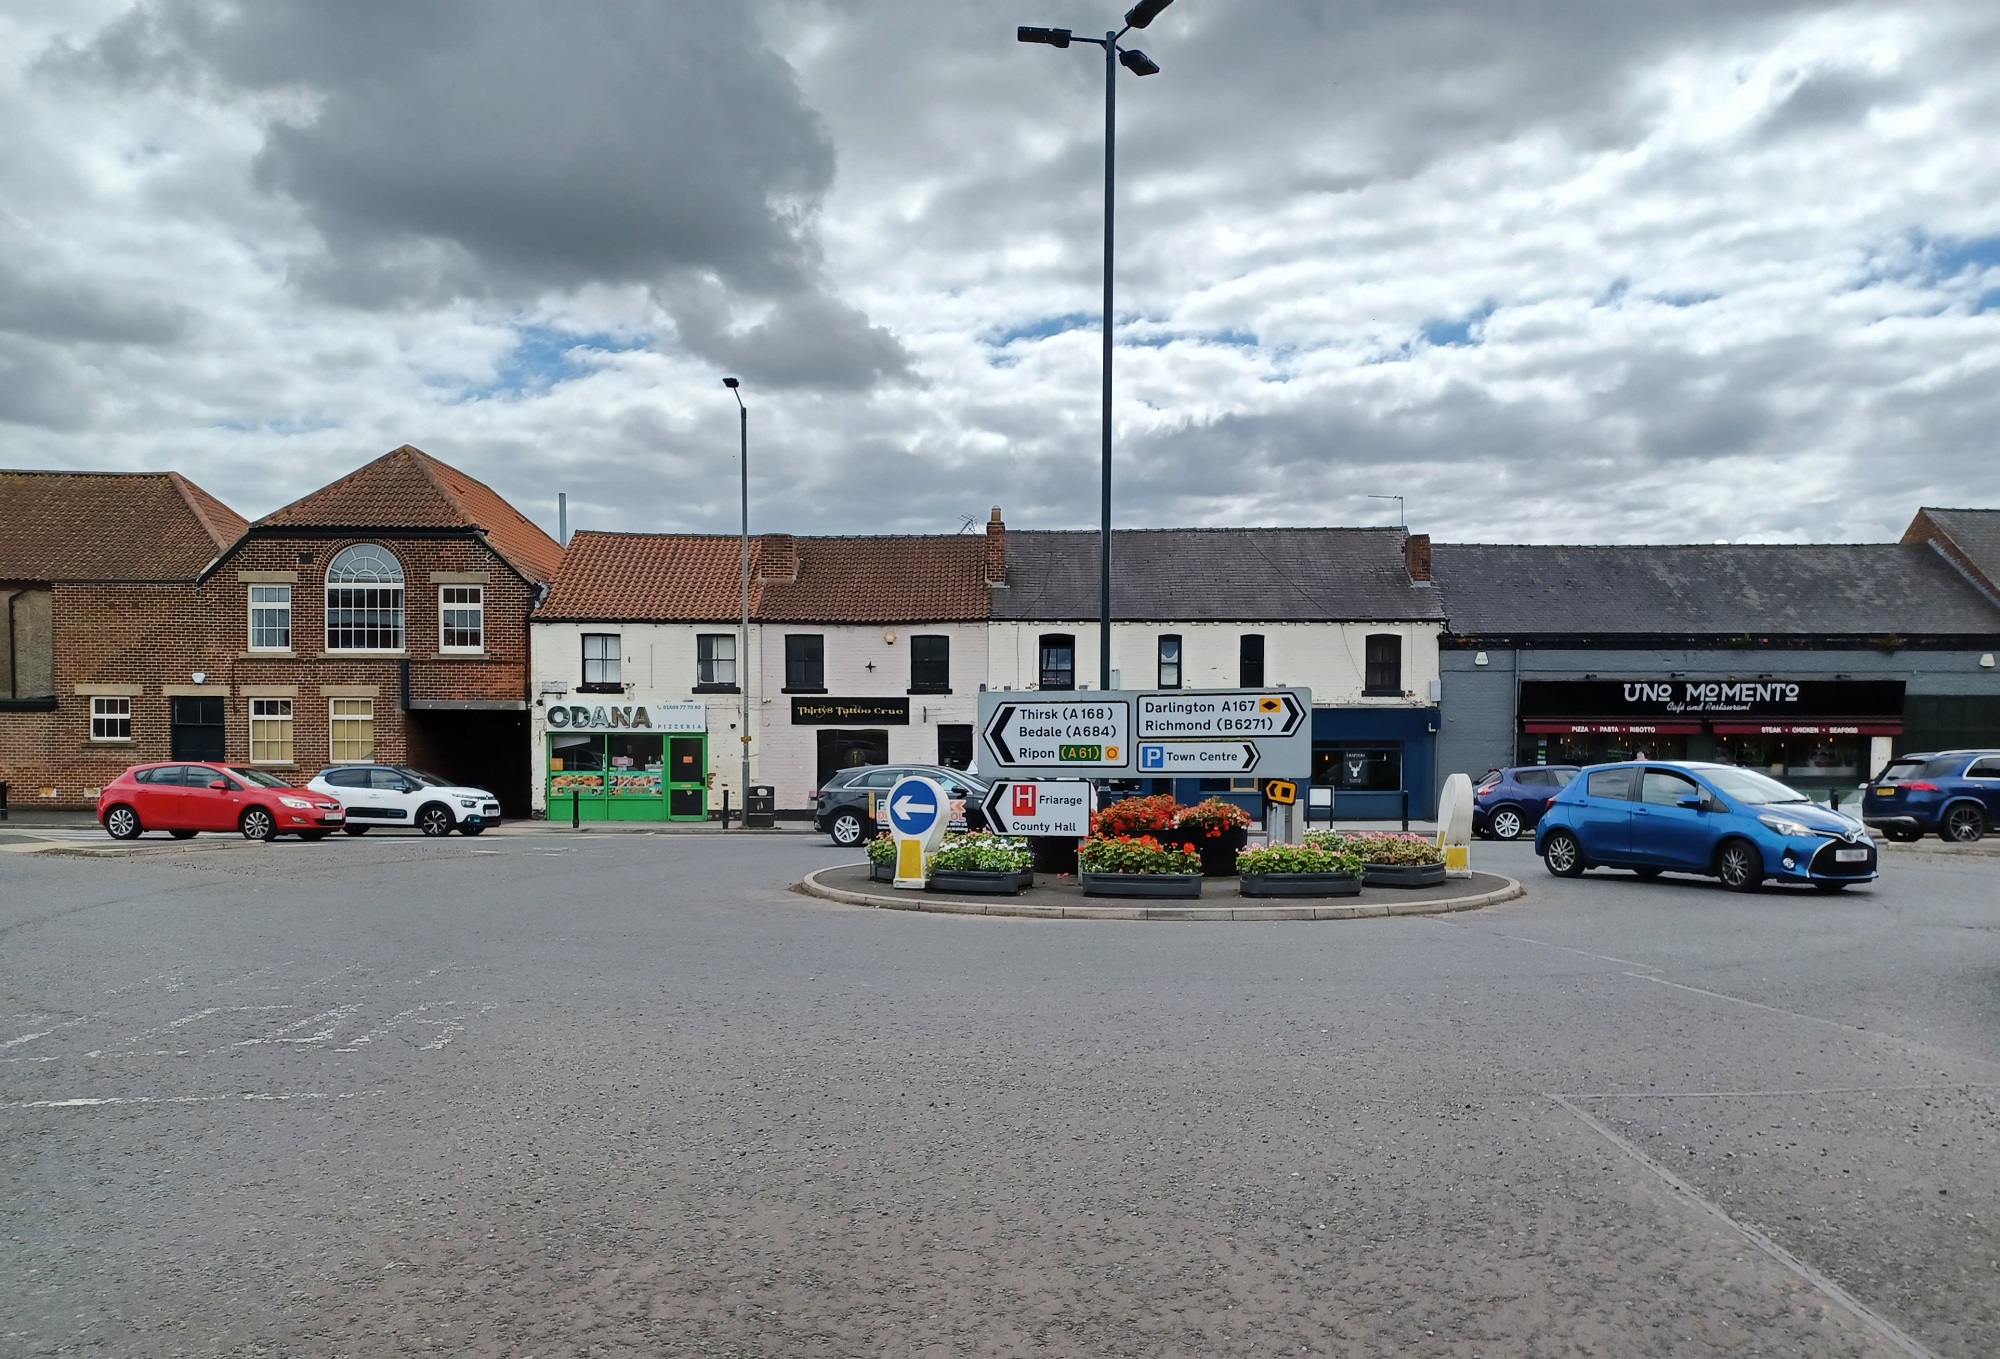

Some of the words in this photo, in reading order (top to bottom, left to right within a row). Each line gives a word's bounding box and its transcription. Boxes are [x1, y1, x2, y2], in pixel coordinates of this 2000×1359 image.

[1623, 683, 1672, 702] UNO
[1685, 683, 1800, 702] MOMENTO
[797, 704, 833, 718] Thirty8
[835, 704, 872, 717] Tattoo
[874, 707, 904, 715] Crue
[1145, 701, 1215, 715] Darlington
[1221, 700, 1256, 712] A167
[1686, 701, 1704, 711] and
[1705, 701, 1751, 711] Restaurant
[547, 705, 653, 729] ODANA
[1020, 709, 1058, 720] Thirsk
[1062, 707, 1113, 721] (A168)
[1019, 726, 1062, 737] Bedale
[1066, 725, 1117, 738] (A684)
[1145, 719, 1211, 731] Richmond
[1216, 717, 1273, 732] (B6271)
[1761, 726, 1781, 734] STEAK
[1791, 726, 1819, 734] CHICKEN
[1829, 726, 1858, 734] SEAFOOD
[1019, 748, 1055, 760] Ripon
[1061, 746, 1100, 759] (A61)
[1147, 748, 1161, 767] P
[1166, 752, 1196, 762] Town
[1199, 752, 1238, 762] Centre
[1016, 786, 1033, 808] H
[1039, 795, 1083, 807] Friarage
[1012, 822, 1050, 833] County
[1054, 822, 1077, 832] Hall
